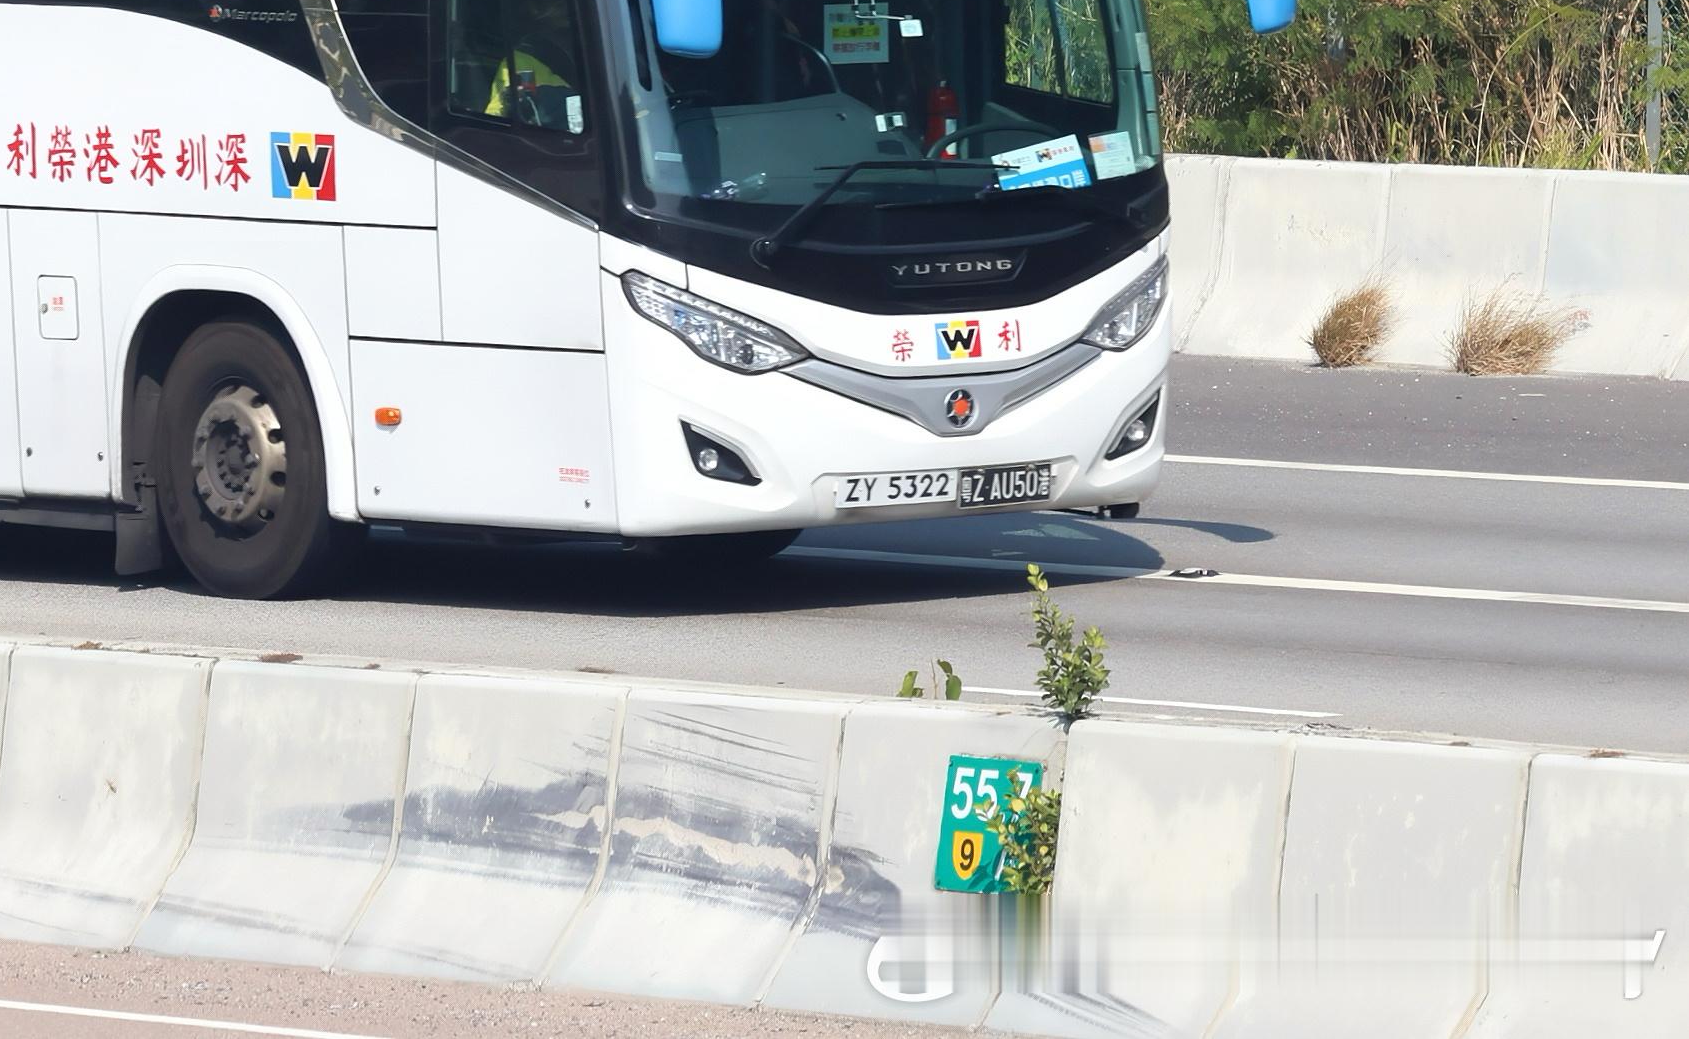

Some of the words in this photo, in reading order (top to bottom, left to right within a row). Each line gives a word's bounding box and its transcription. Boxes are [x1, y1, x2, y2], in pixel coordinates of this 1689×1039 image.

[892, 260, 1012, 275] YUTONG
[998, 319, 1021, 352] 利
[845, 477, 877, 502] ZY
[887, 473, 950, 500] 5322
[960, 839, 974, 871] 9
